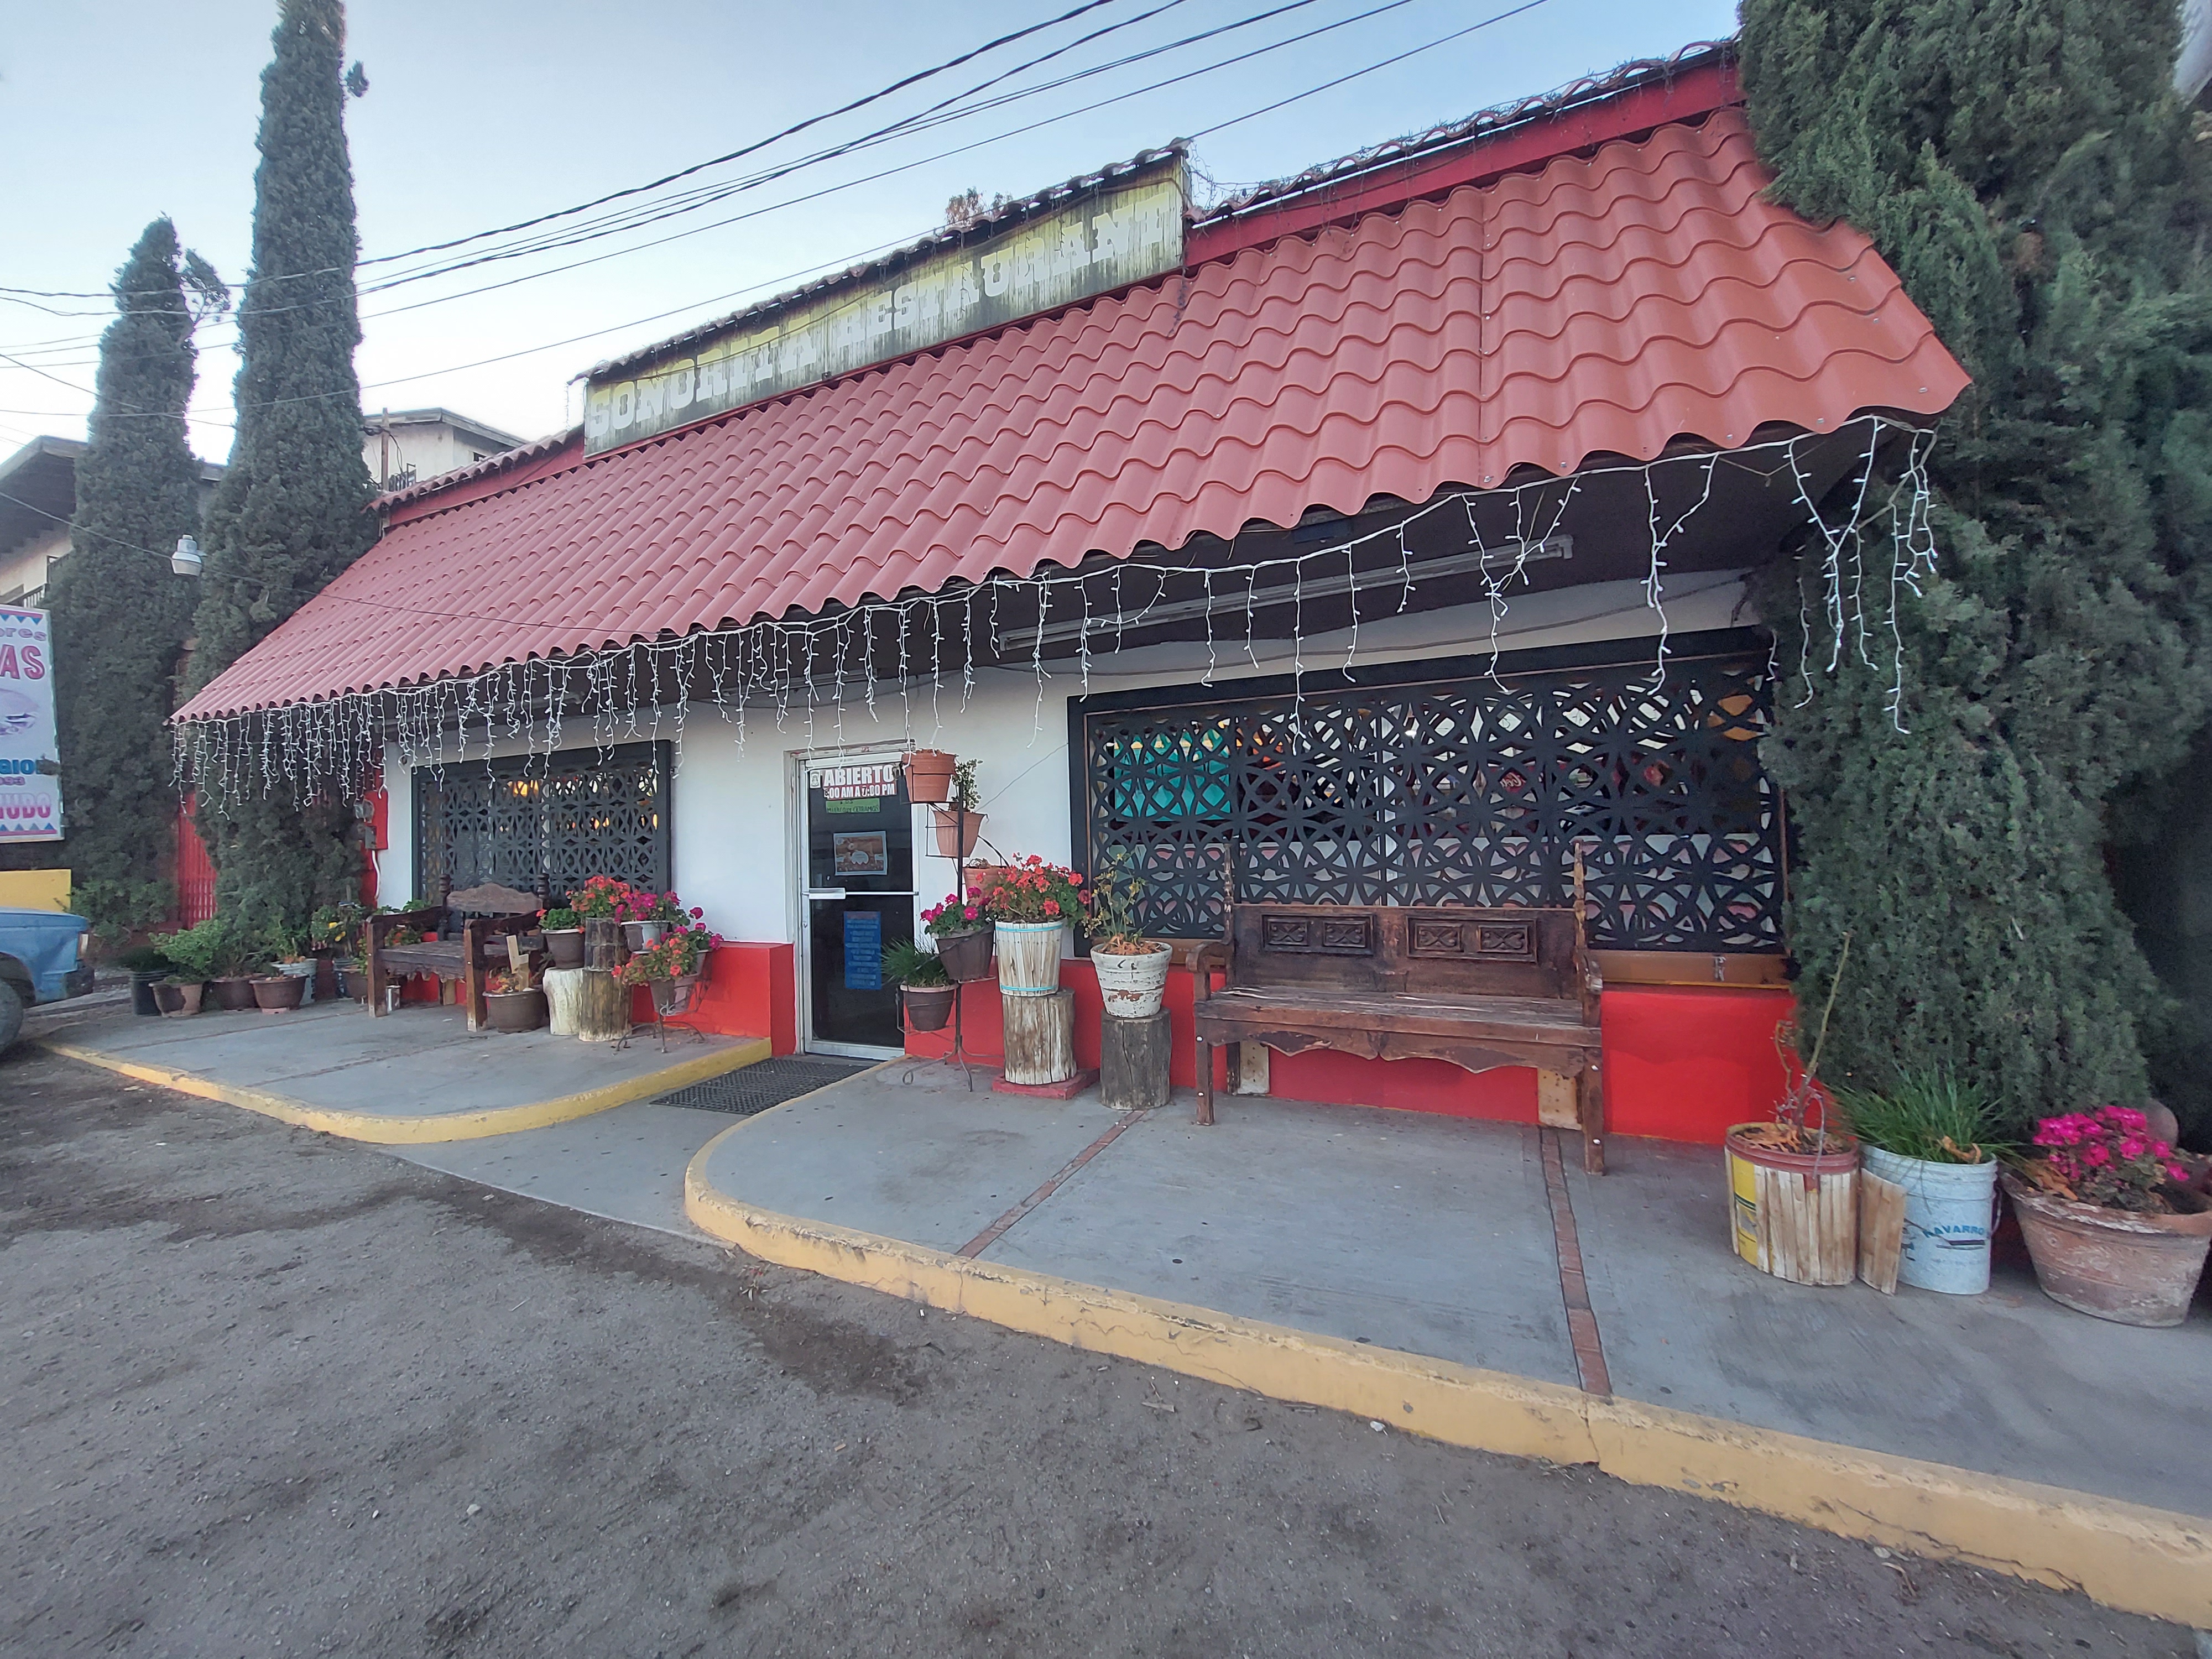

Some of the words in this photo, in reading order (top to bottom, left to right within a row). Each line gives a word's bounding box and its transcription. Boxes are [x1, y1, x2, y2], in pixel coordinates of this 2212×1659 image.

[589, 314, 817, 438] SONORITA
[836, 192, 1170, 348] RESTAURANT
[823, 764, 894, 786] ABIERTO
[841, 786, 853, 798] AM
[854, 786, 861, 797] A
[862, 785, 880, 796] 7:00
[881, 783, 895, 795] PM
